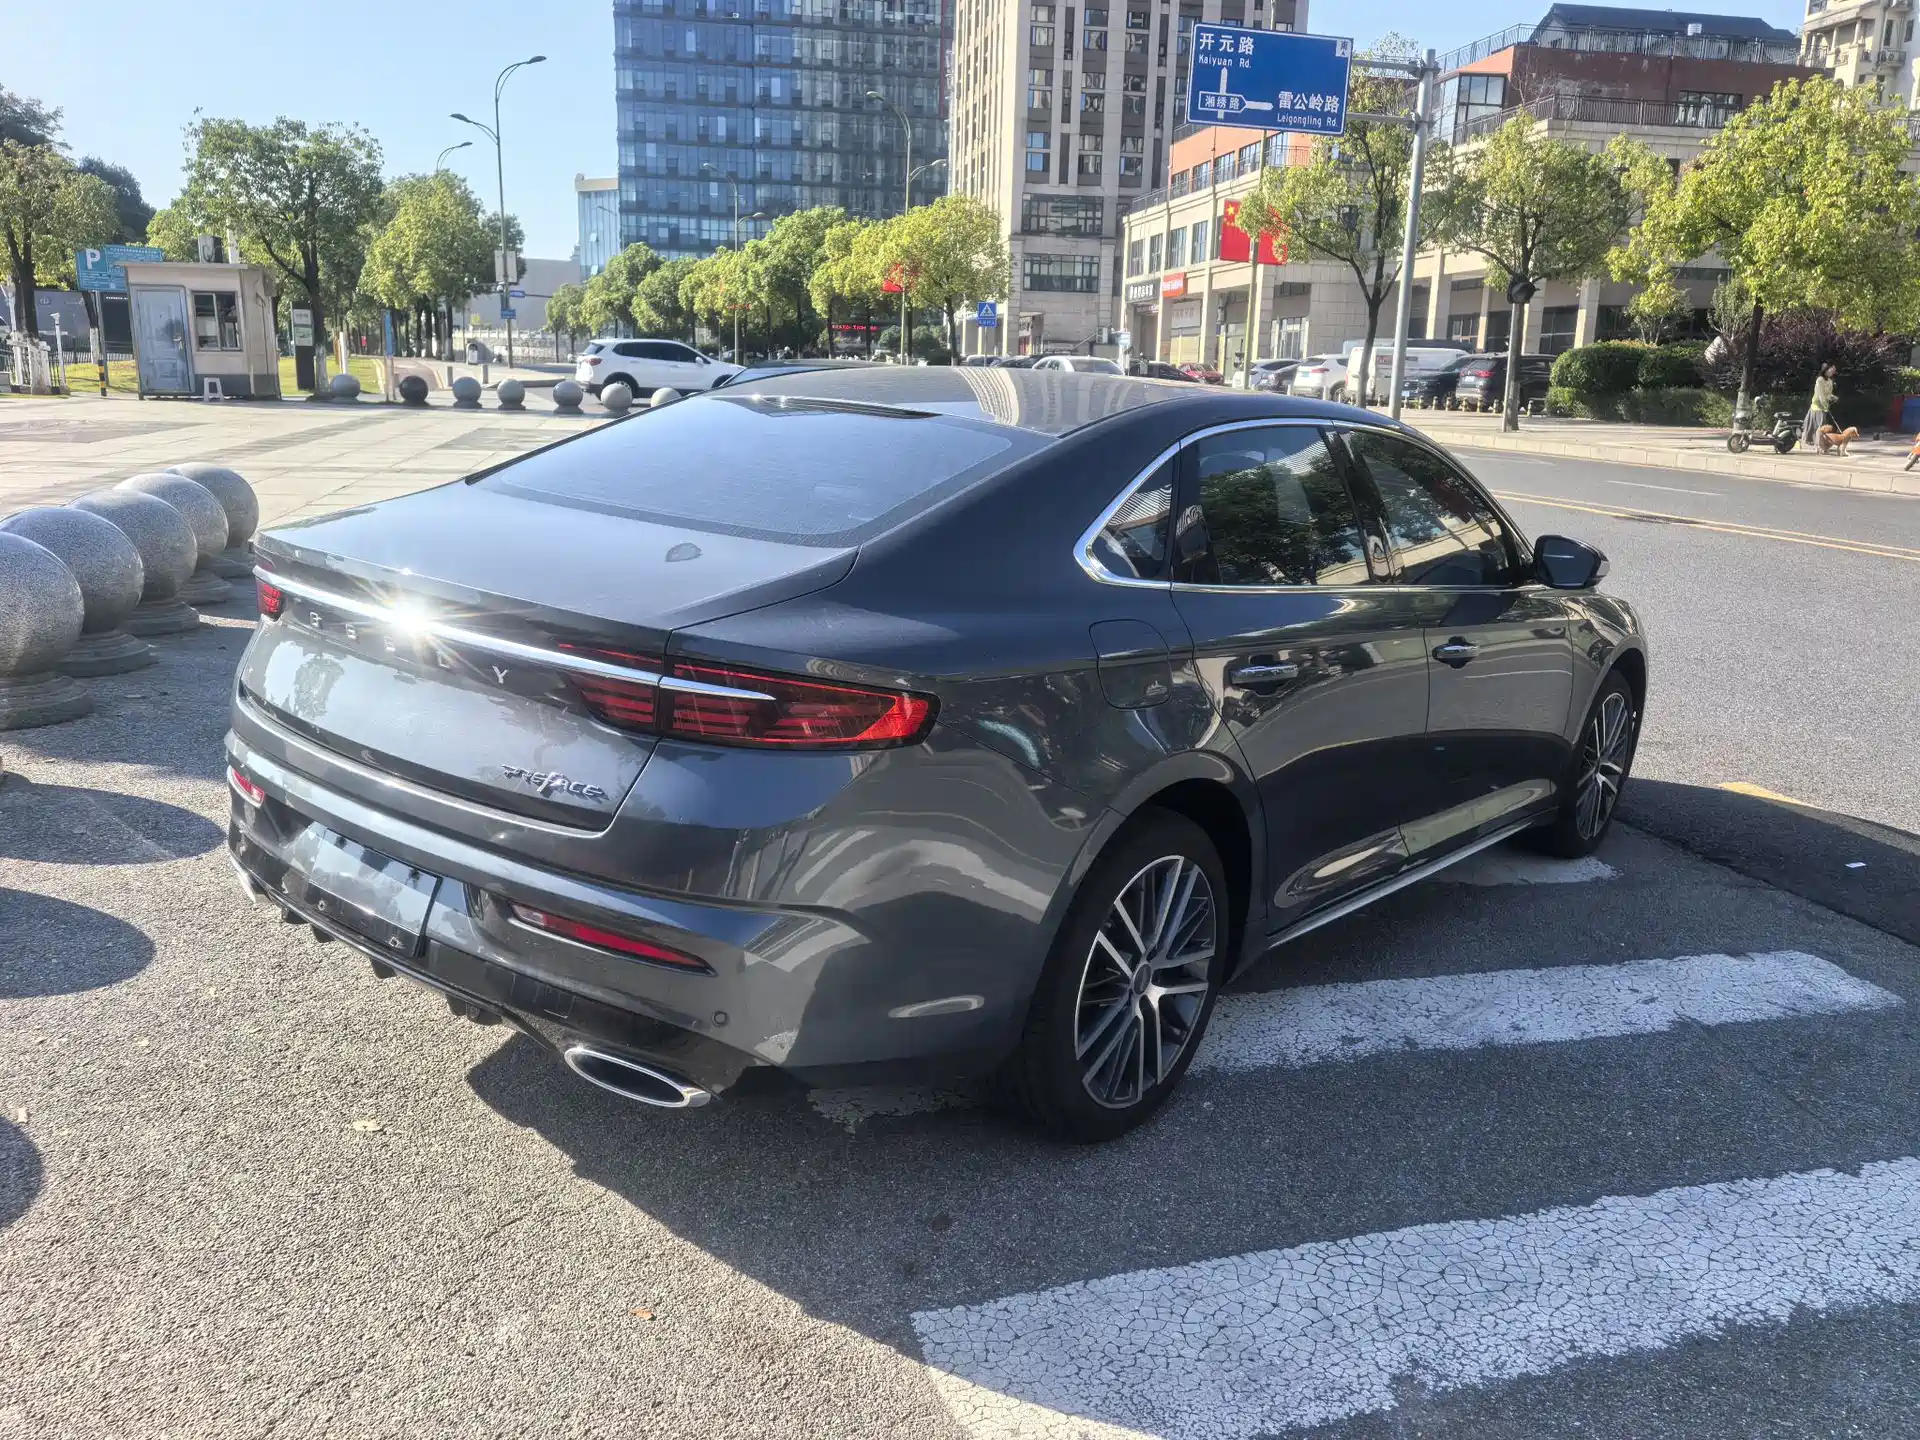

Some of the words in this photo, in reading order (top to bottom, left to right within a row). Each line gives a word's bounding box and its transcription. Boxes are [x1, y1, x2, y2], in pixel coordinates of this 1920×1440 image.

[1200, 32, 1254, 55] 开元路
[1199, 54, 1233, 67] Kaiyuan
[1240, 57, 1252, 69] Rd.
[1205, 95, 1240, 110] 湘绣路
[1278, 91, 1340, 113] 雷公岭路
[1277, 112, 1322, 128] Leigongling
[1326, 116, 1338, 127] Rd.
[86, 248, 101, 270] P
